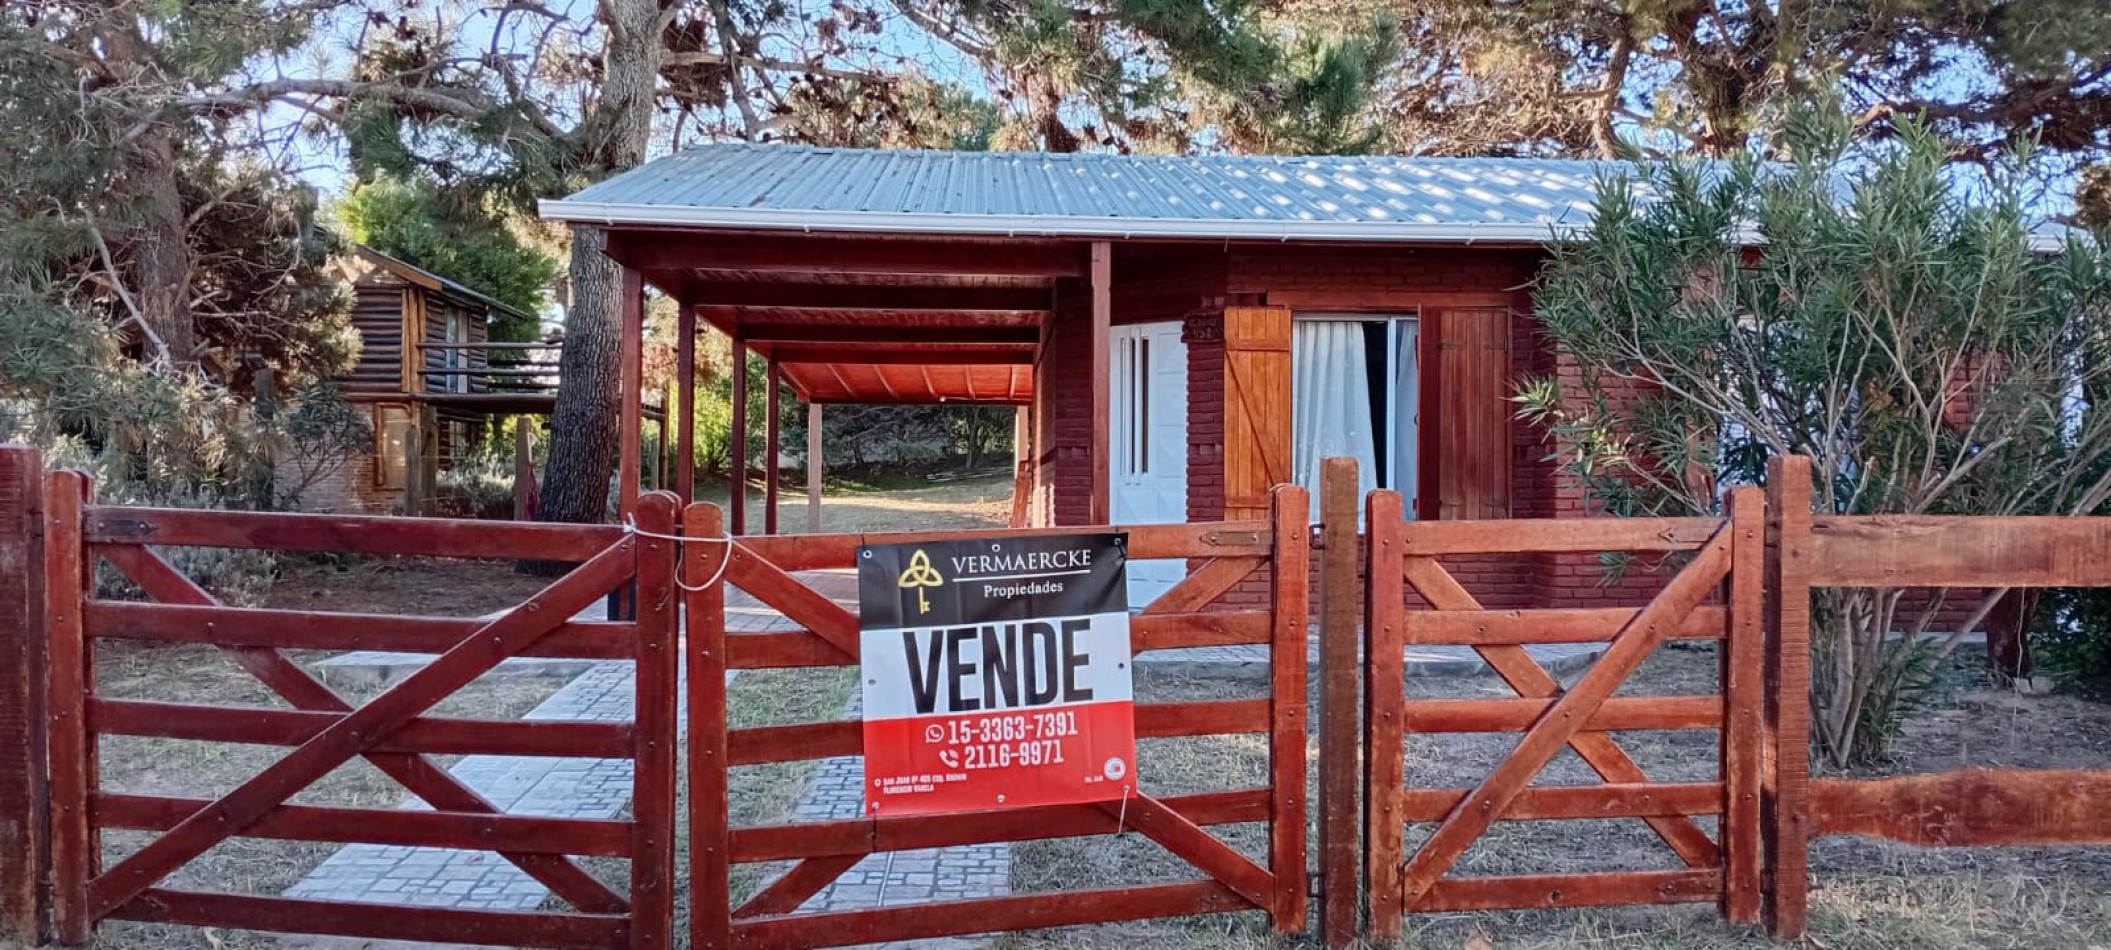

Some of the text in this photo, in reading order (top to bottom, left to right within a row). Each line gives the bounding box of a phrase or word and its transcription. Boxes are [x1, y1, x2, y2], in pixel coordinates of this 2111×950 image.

[952, 550, 1092, 574] VERMAERCKE
[984, 581, 1064, 599] Propiedades
[902, 618, 1093, 714] VENDE
[948, 711, 1078, 744] 15-3363-7391
[965, 739, 1064, 769] 2116-9971
